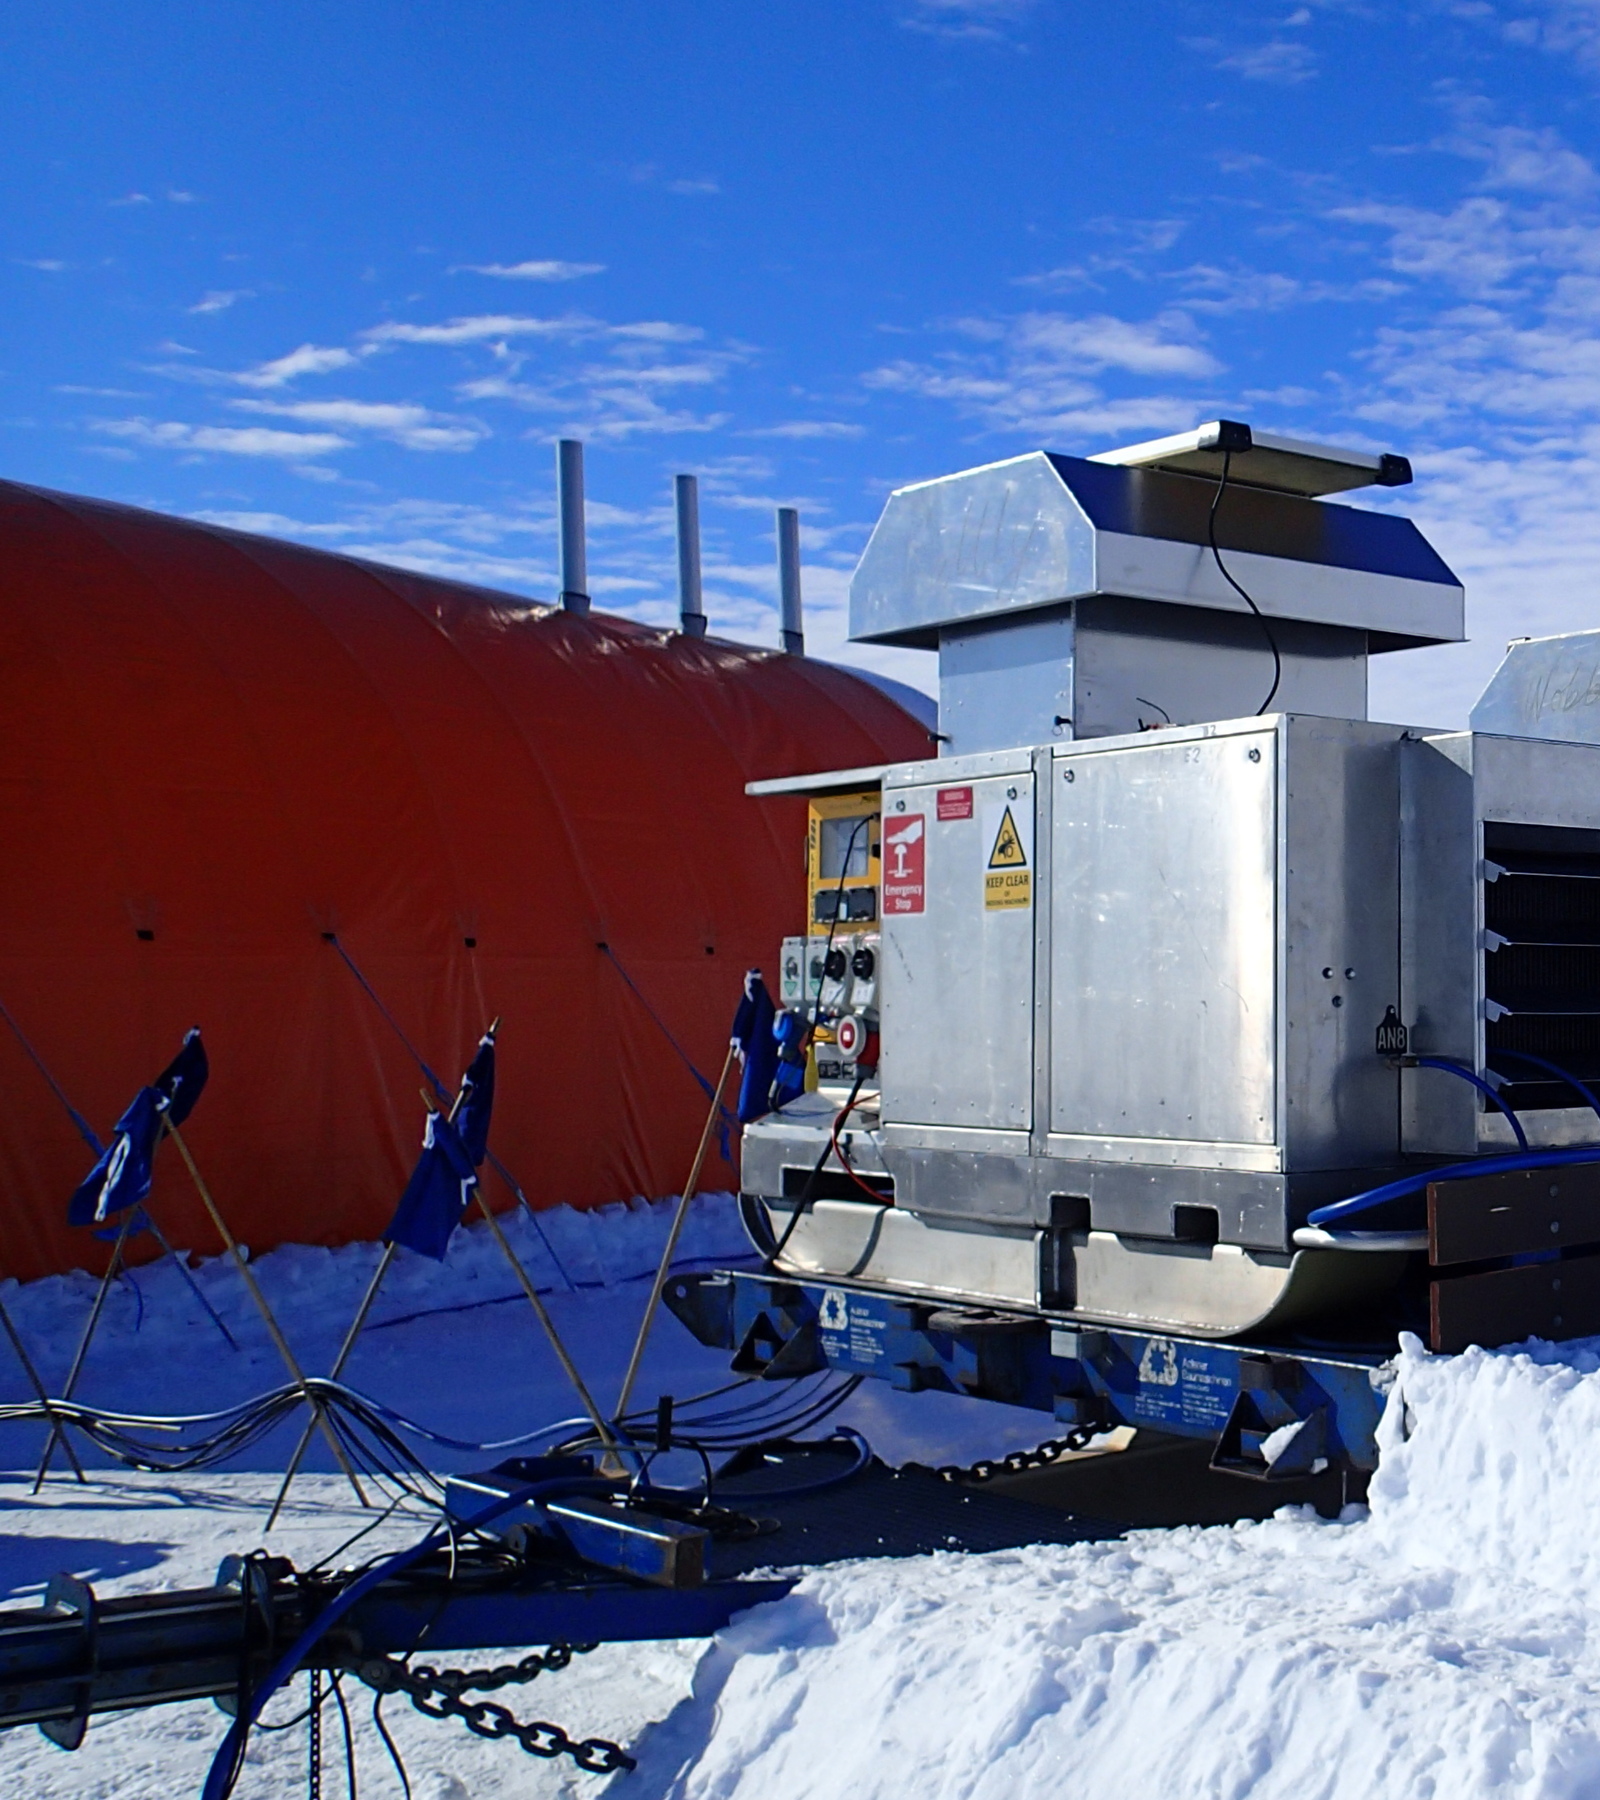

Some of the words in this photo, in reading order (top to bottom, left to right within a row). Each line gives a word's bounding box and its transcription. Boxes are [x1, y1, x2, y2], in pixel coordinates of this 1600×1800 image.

[985, 876, 1004, 888] KEEP
[1005, 875, 1029, 887] CLEAR
[885, 884, 922, 897] Emergency
[895, 898, 912, 911] Stop
[1378, 1026, 1406, 1049] AN8
